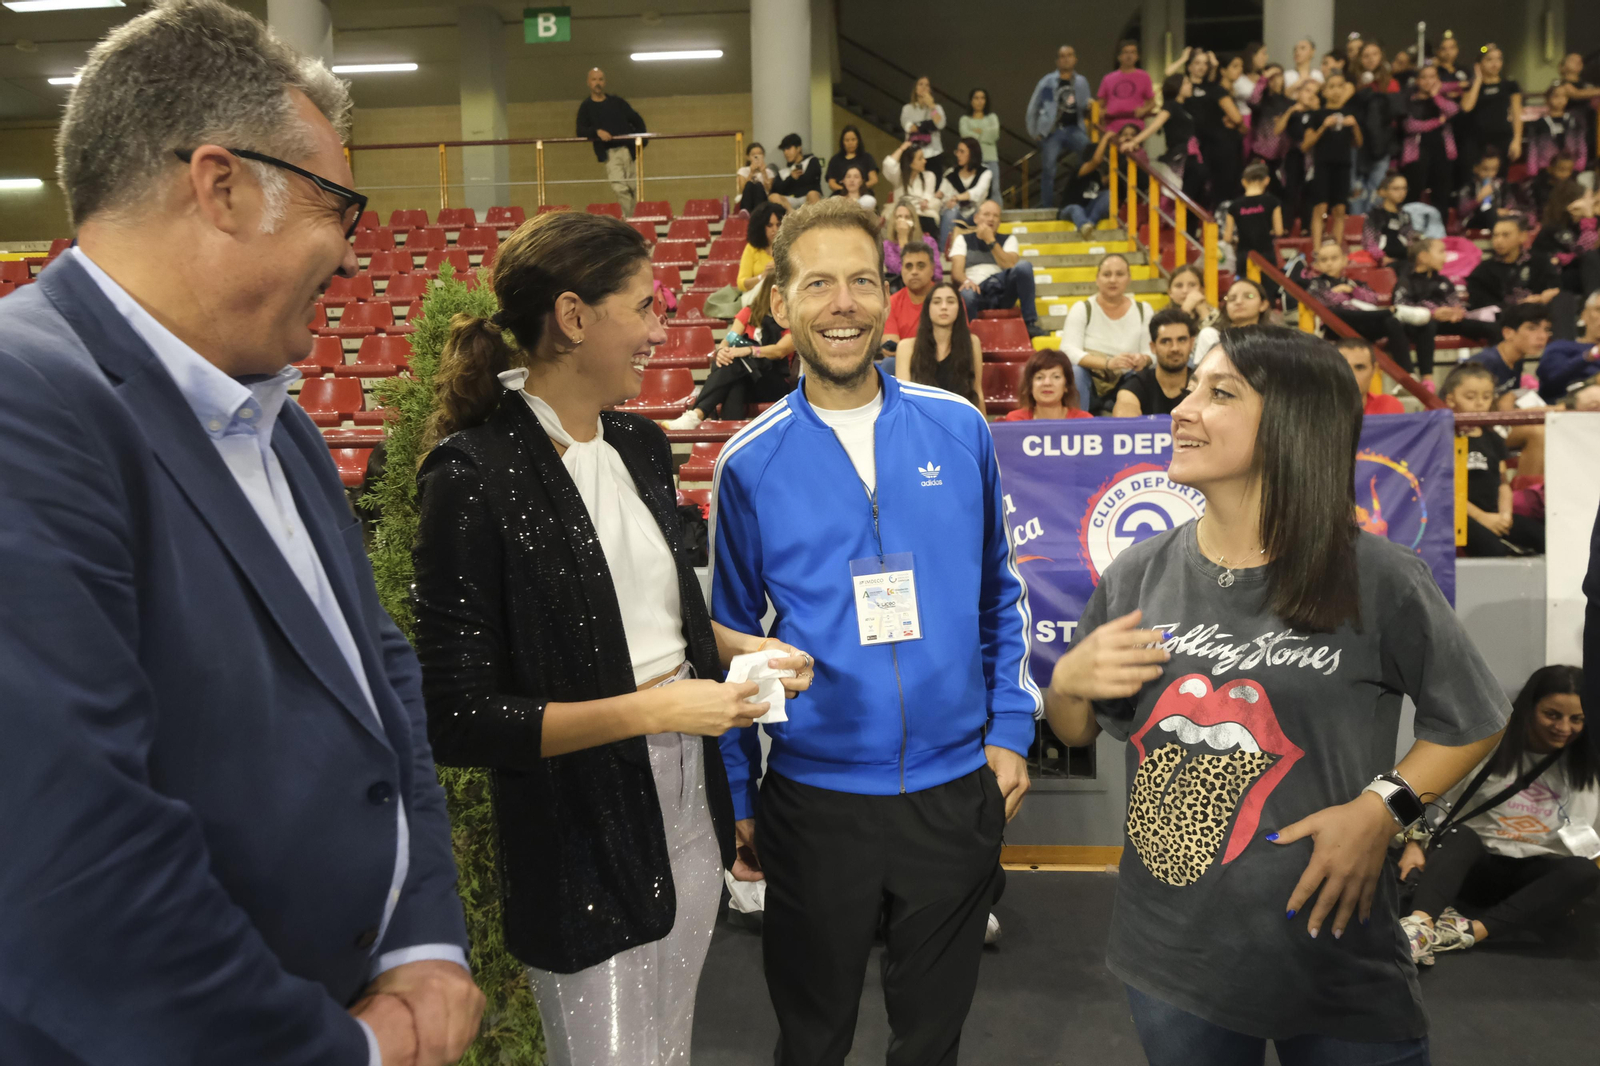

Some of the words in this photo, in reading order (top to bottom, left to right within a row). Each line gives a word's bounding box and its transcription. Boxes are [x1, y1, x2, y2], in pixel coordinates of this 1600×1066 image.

[537, 13, 557, 37] B
[1022, 434, 1103, 456] CLUB
[1113, 433, 1172, 455] DEP
[920, 479, 943, 487] adidas
[1093, 488, 1126, 528] CLUB
[1130, 477, 1206, 508] DEPORTI
[1035, 620, 1078, 643] ST
[1238, 628, 1342, 676] Stones
[1506, 800, 1553, 817] umbro
